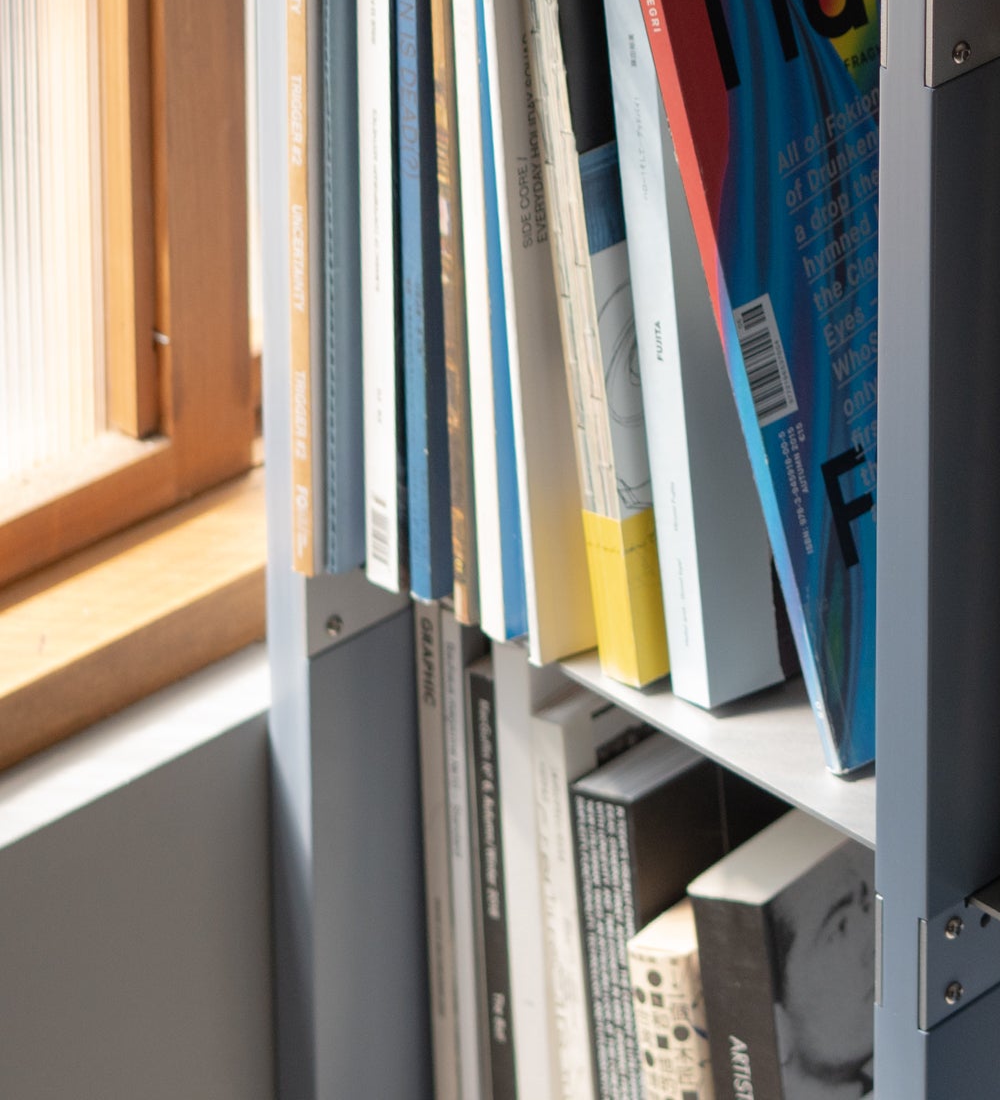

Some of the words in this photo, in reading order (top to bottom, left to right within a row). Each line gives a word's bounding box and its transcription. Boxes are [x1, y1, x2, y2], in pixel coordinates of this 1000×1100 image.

[400, 34, 417, 59] IS
[290, 75, 303, 148] TRIGGER
[777, 140, 800, 175] All
[804, 122, 821, 154] of
[517, 169, 531, 208] CORE
[530, 162, 549, 244] EVERYDAY
[786, 177, 803, 207] of
[521, 212, 534, 249] SIDE
[794, 224, 806, 244] a
[810, 192, 850, 231] drop
[291, 204, 305, 312] UNCERTAINTY
[802, 211, 871, 279] hymned
[813, 280, 843, 311] the
[653, 320, 665, 363] FUJITA
[823, 306, 865, 348] Eyes
[792, 451, 810, 494] AUTUMN
[420, 616, 437, 707] GRAPHIC
